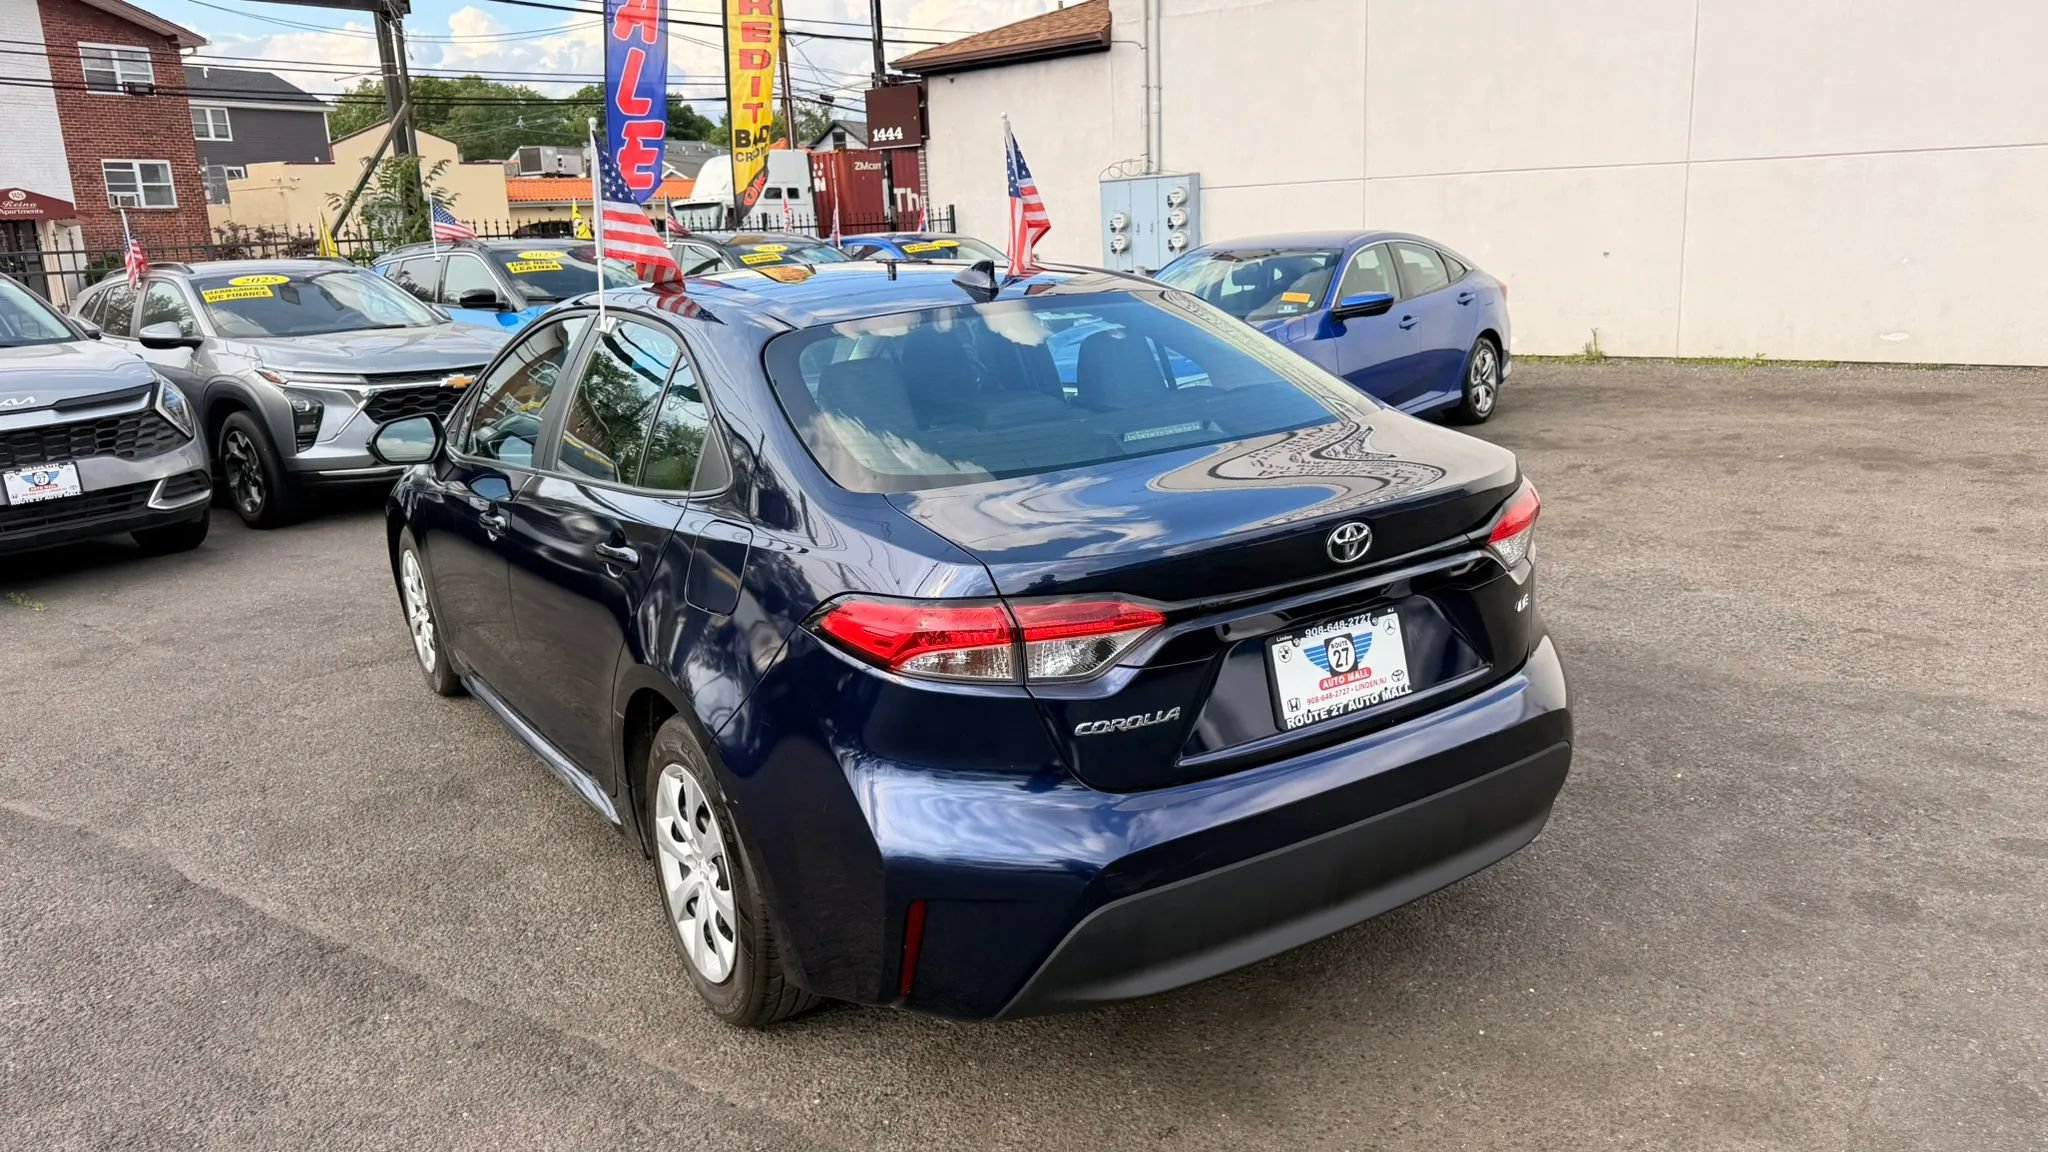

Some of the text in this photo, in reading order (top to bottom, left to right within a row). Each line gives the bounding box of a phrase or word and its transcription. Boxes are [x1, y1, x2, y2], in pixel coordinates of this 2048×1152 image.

[872, 127, 904, 142] 1444
[226, 290, 269, 298] FINANCE
[36, 475, 47, 484] 27
[1305, 613, 1372, 638] 908-648-2727
[1330, 640, 1349, 649] ROUTE
[1333, 647, 1350, 669] 27
[1323, 669, 1369, 689] AUTO MALL
[1306, 687, 1350, 705] 908-648-2727
[1287, 683, 1413, 729] ROUTE 27 AUTO MALL
[1074, 706, 1181, 736] COROLLA
